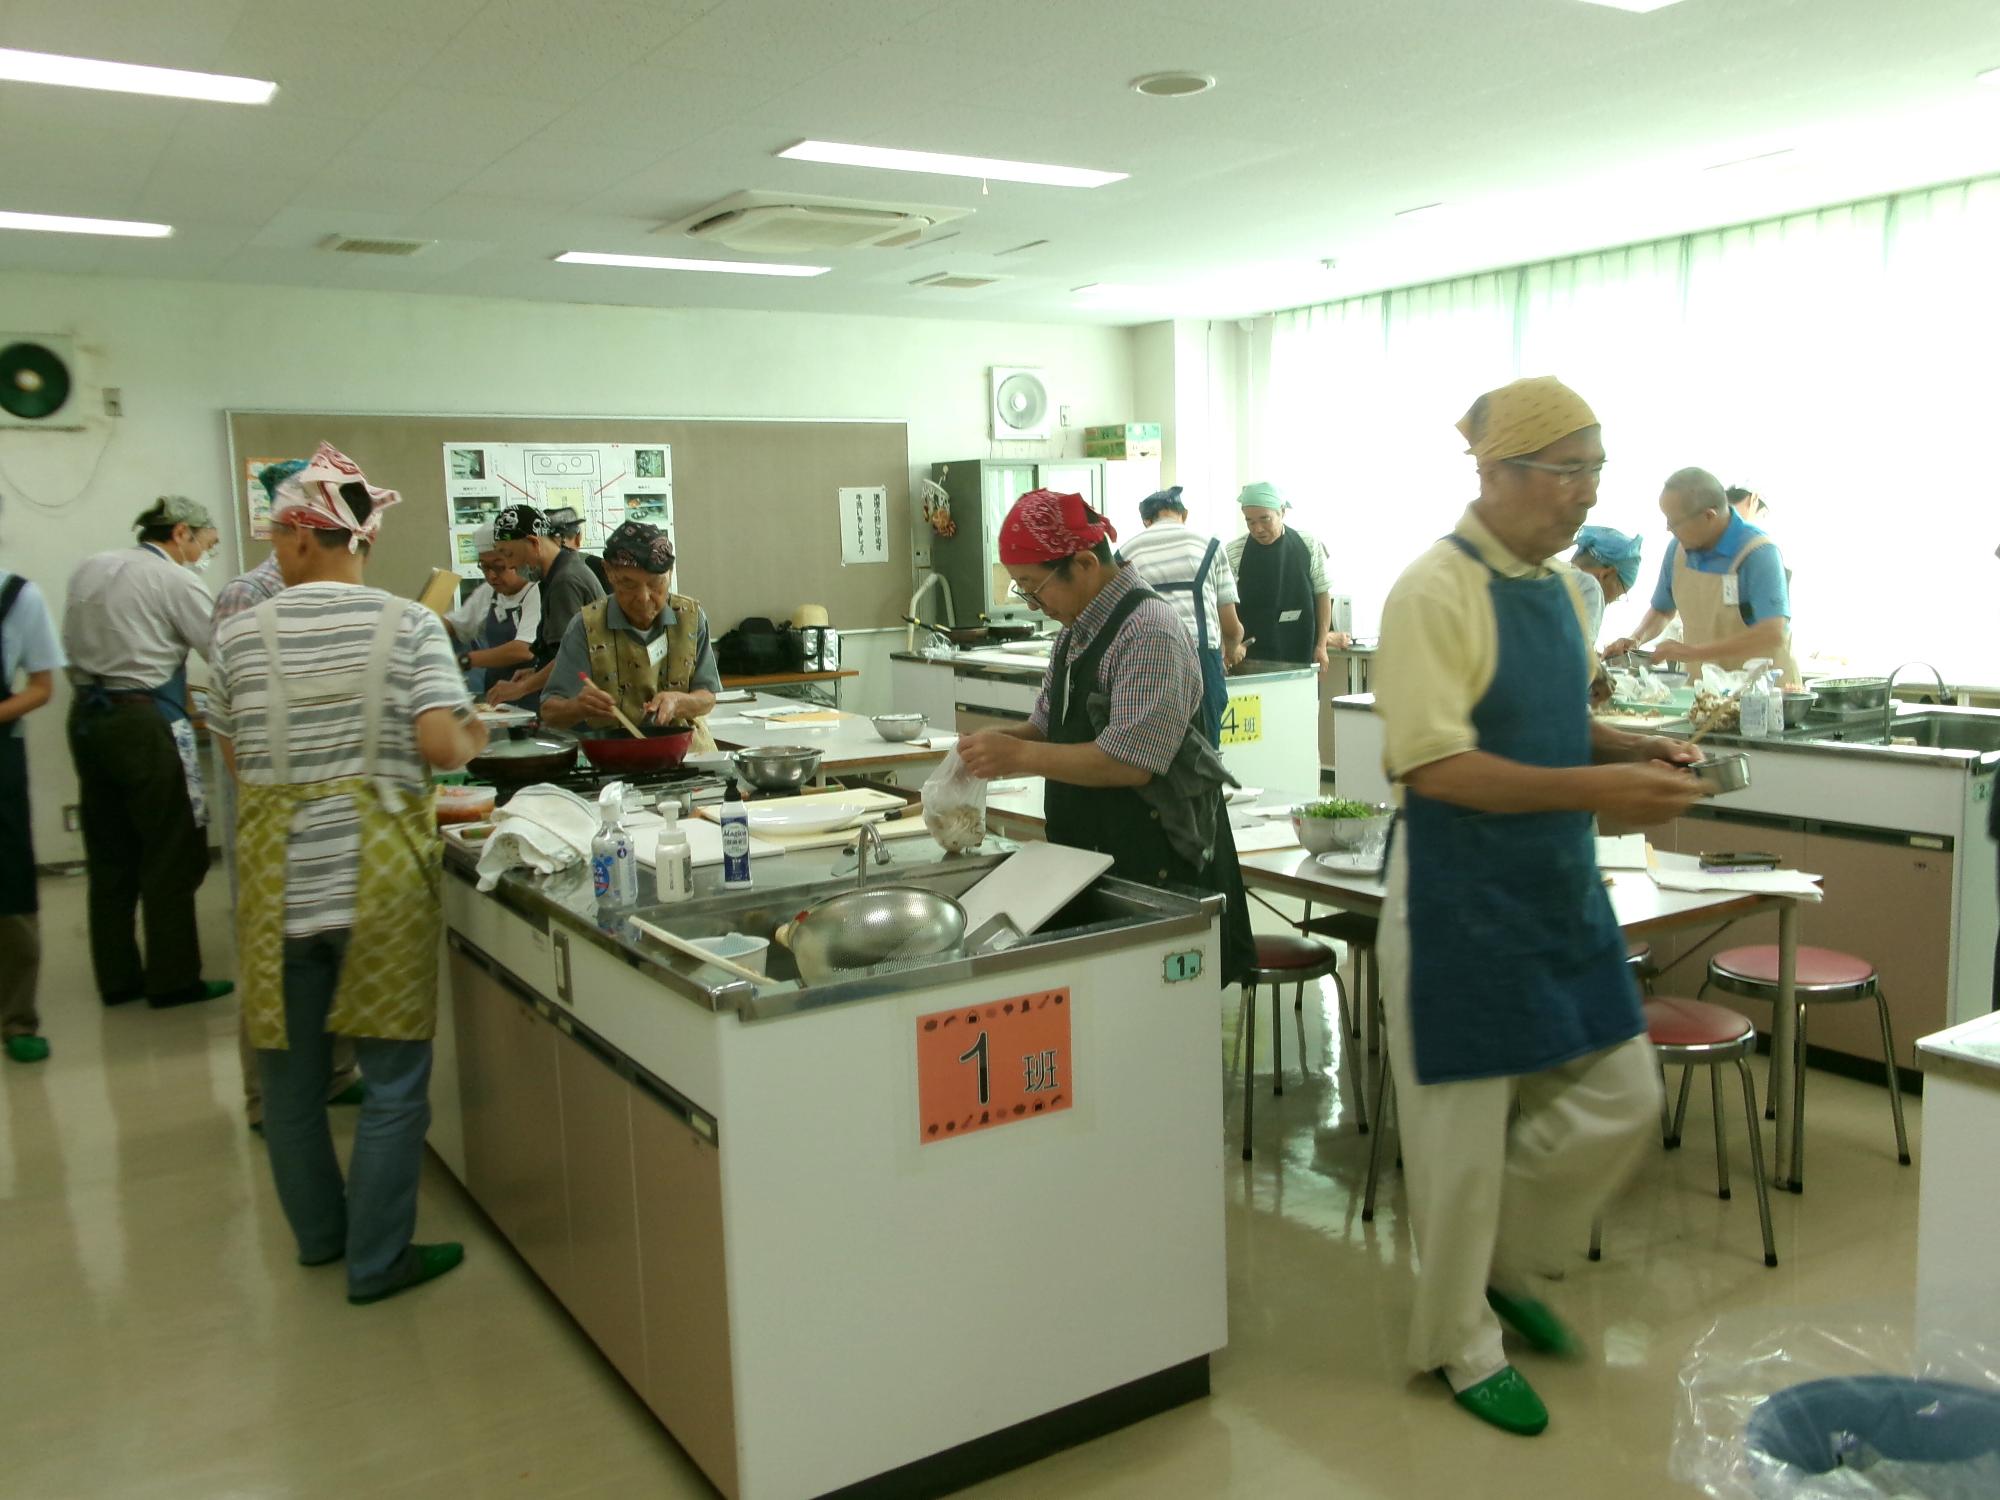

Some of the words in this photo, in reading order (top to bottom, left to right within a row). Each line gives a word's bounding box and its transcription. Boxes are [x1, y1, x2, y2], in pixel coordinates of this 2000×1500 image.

[1220, 706, 1240, 735] 4
[958, 1031, 990, 1106] 1
[1022, 1049, 1060, 1093] 班
